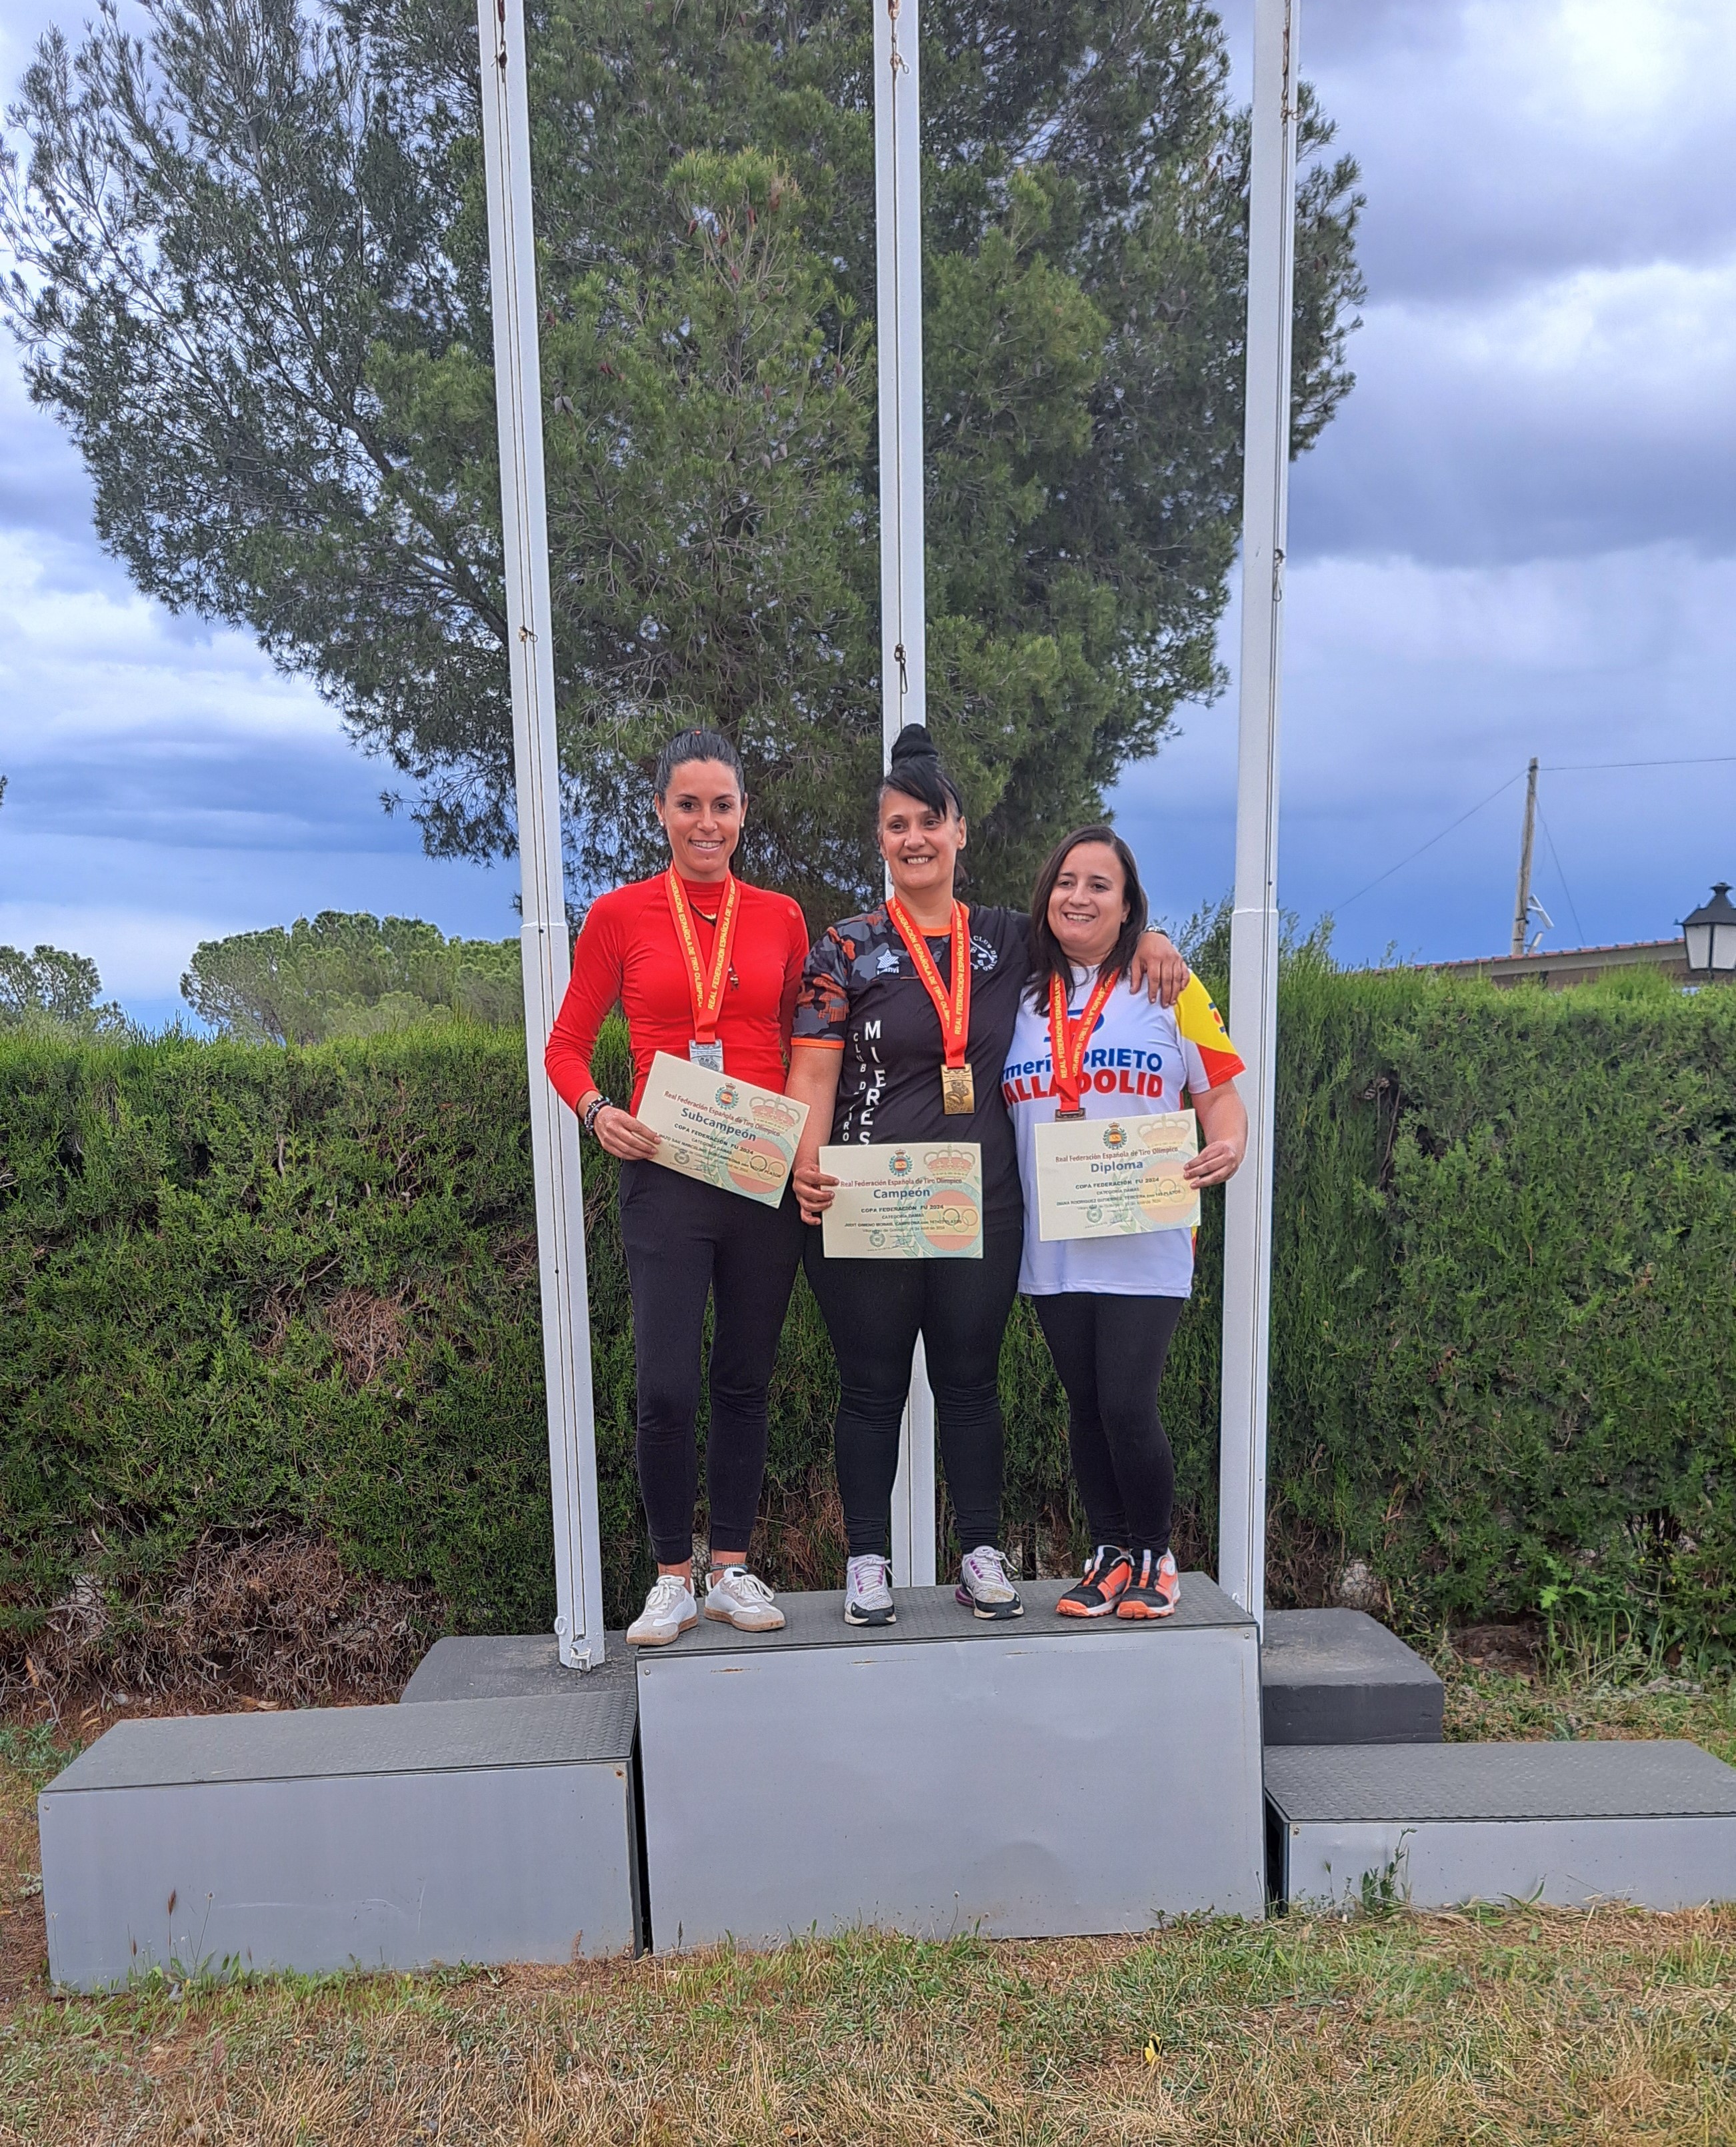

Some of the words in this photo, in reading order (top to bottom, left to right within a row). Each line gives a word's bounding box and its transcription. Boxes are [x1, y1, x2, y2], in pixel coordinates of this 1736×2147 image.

[679, 913, 693, 947] ESPAÑOLA
[957, 931, 964, 940] DE
[687, 947, 696, 956] DE
[707, 991, 718, 1011] REAL
[725, 907, 732, 917] DE
[690, 956, 699, 971] TIRO
[913, 943, 933, 977] ESPAÑOLA
[928, 975, 938, 986] DE
[933, 985, 945, 1001] TIRO
[954, 1017, 963, 1035] REAL
[1084, 1017, 1093, 1026] DE
[1079, 1027, 1090, 1041] TIRO
[1059, 1059, 1068, 1078] REAL
[859, 1020, 886, 1145] MIERES
[1003, 1069, 1163, 1105] ALLADOLID
[664, 1090, 677, 1100] Real
[677, 1094, 709, 1111] Federación
[709, 1106, 735, 1121] Española
[743, 1118, 754, 1128] Tiro
[681, 1107, 757, 1141] Subcampeón
[674, 1123, 690, 1132] COPA
[691, 1129, 728, 1146] FEDERACIÓN
[1069, 1153, 1101, 1162] Federación
[1102, 1150, 1129, 1160] Española
[1091, 1161, 1143, 1174] Diploma
[873, 1187, 930, 1200] Campeón
